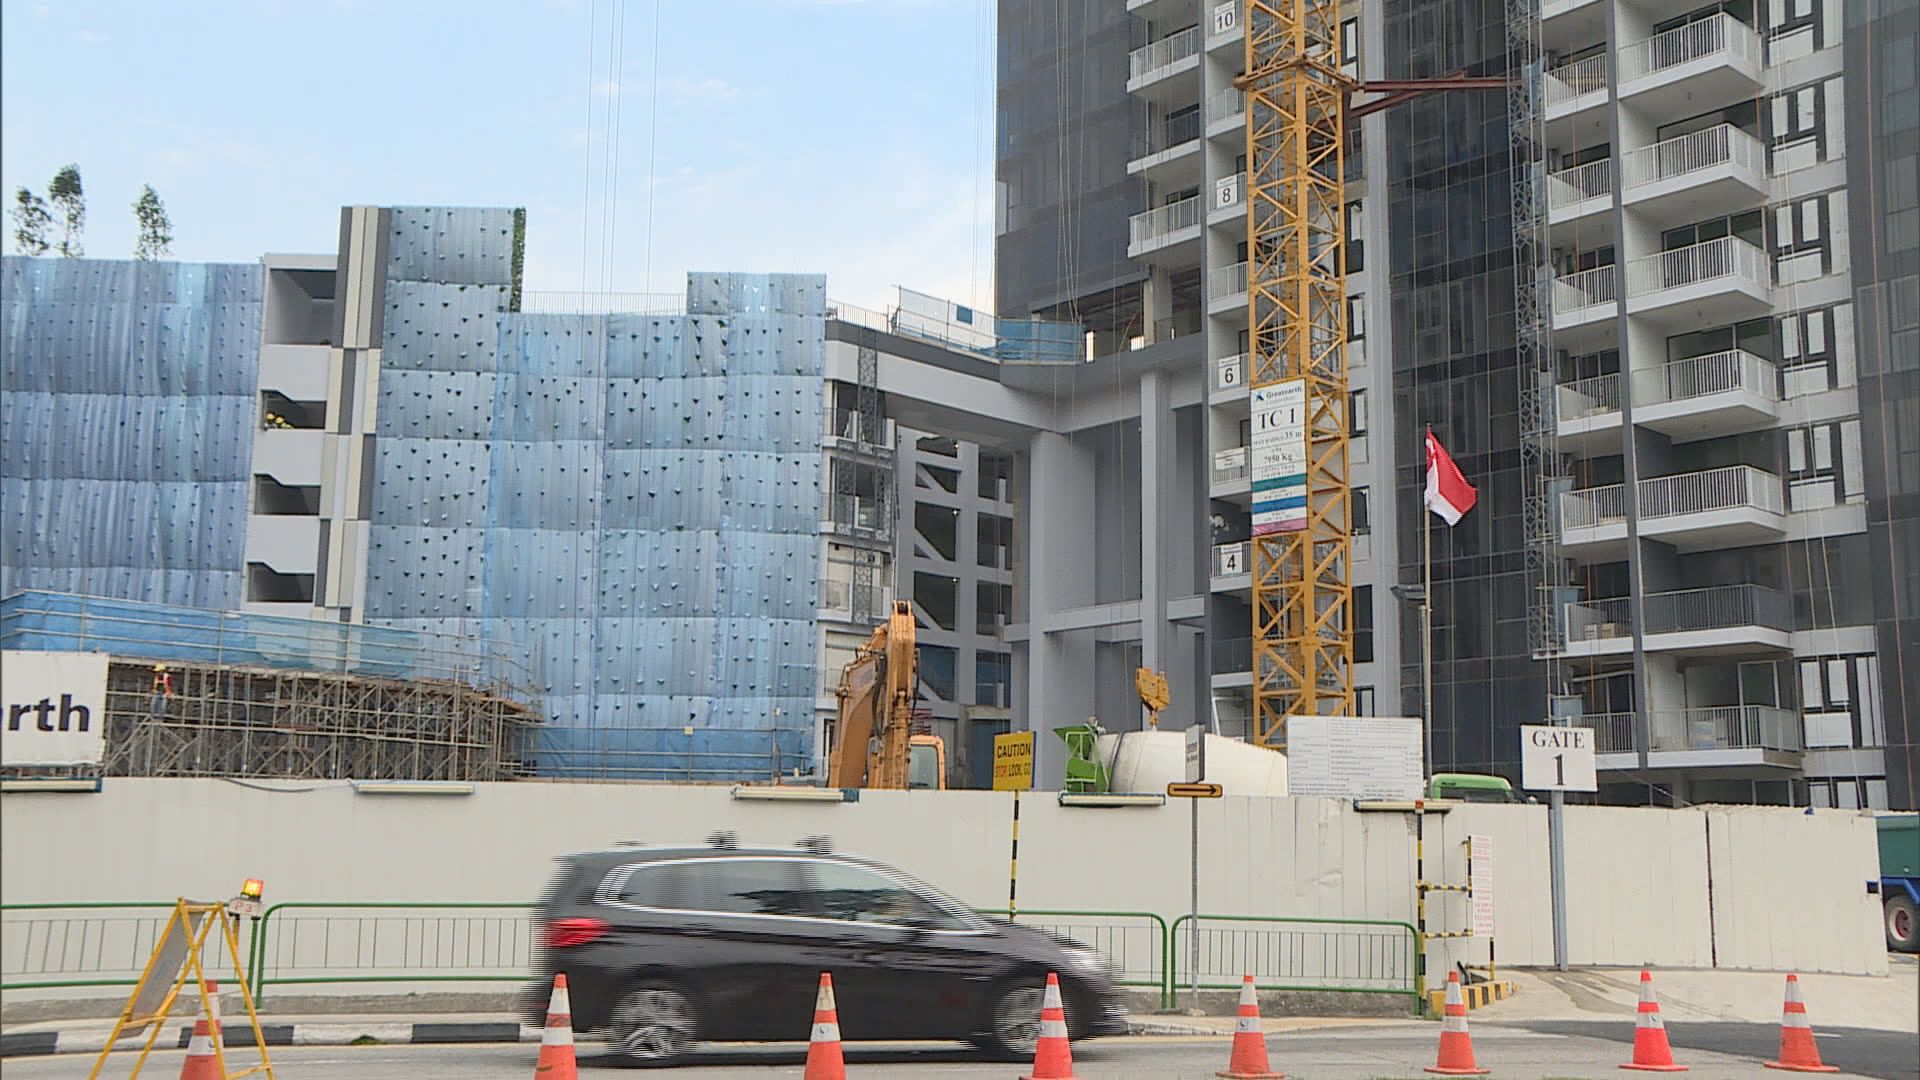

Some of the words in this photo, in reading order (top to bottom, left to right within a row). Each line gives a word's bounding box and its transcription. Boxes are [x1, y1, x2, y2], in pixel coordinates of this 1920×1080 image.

[1216, 12, 1233, 29] 10
[1223, 187, 1231, 203] 8
[1225, 367, 1233, 383] 6
[1258, 410, 1283, 429] TC
[1264, 455, 1280, 464] 7950
[1227, 554, 1236, 571] 4
[1, 693, 90, 732] rth
[1532, 729, 1585, 749] GATE
[997, 743, 1030, 758] CAUTION
[1552, 753, 1567, 786] 1
